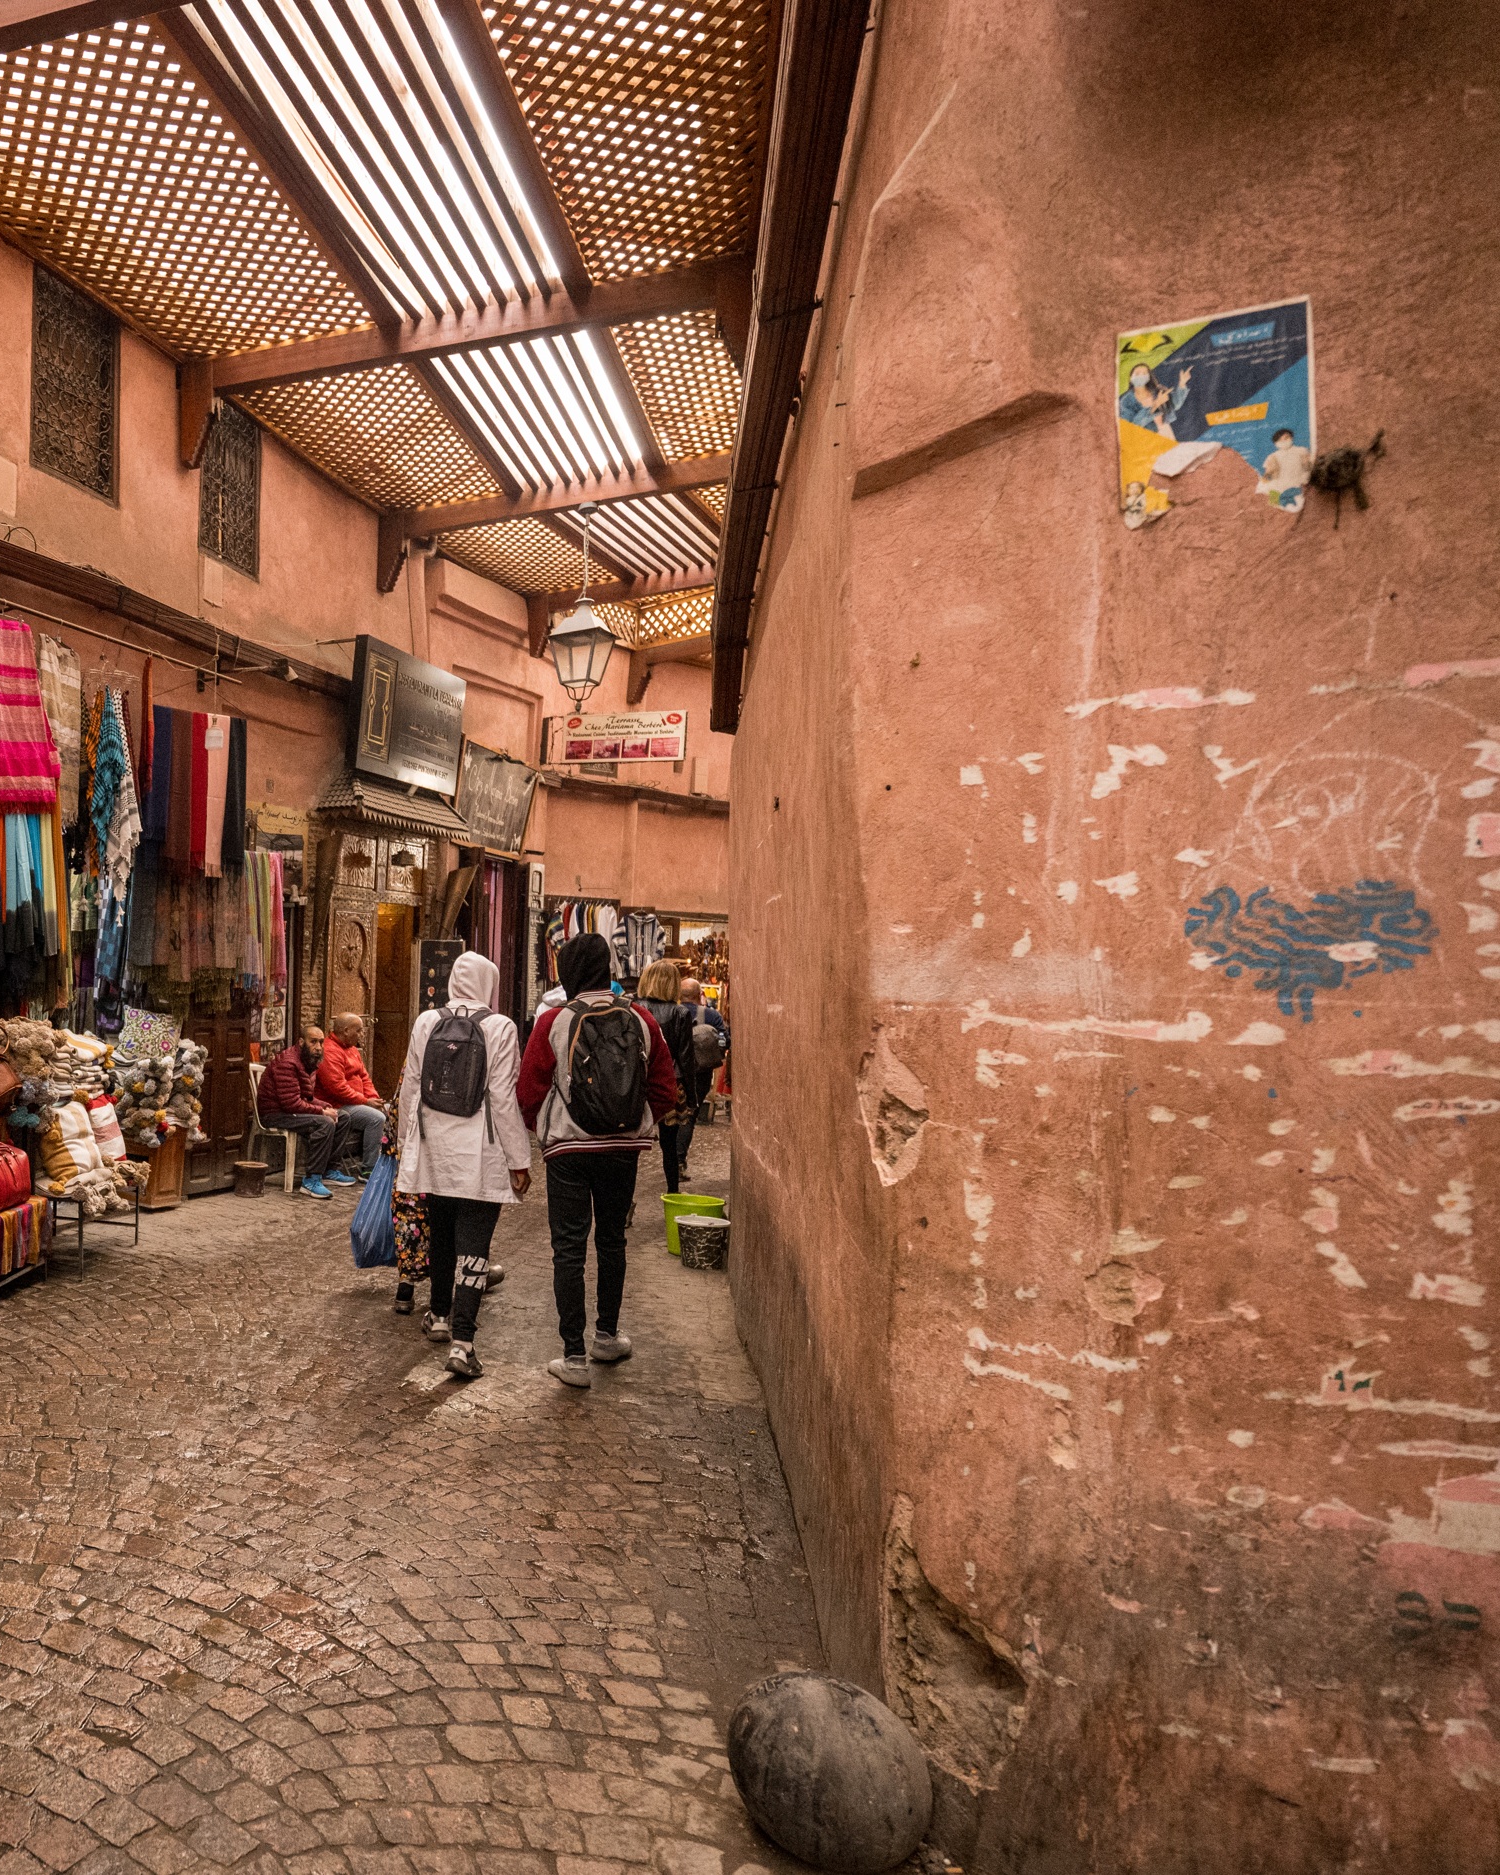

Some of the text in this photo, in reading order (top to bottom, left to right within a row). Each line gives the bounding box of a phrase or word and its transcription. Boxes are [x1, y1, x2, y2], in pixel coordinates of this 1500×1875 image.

[607, 715, 643, 724] Terrasse
[584, 723, 601, 731] Chez
[601, 723, 634, 731] Mariama
